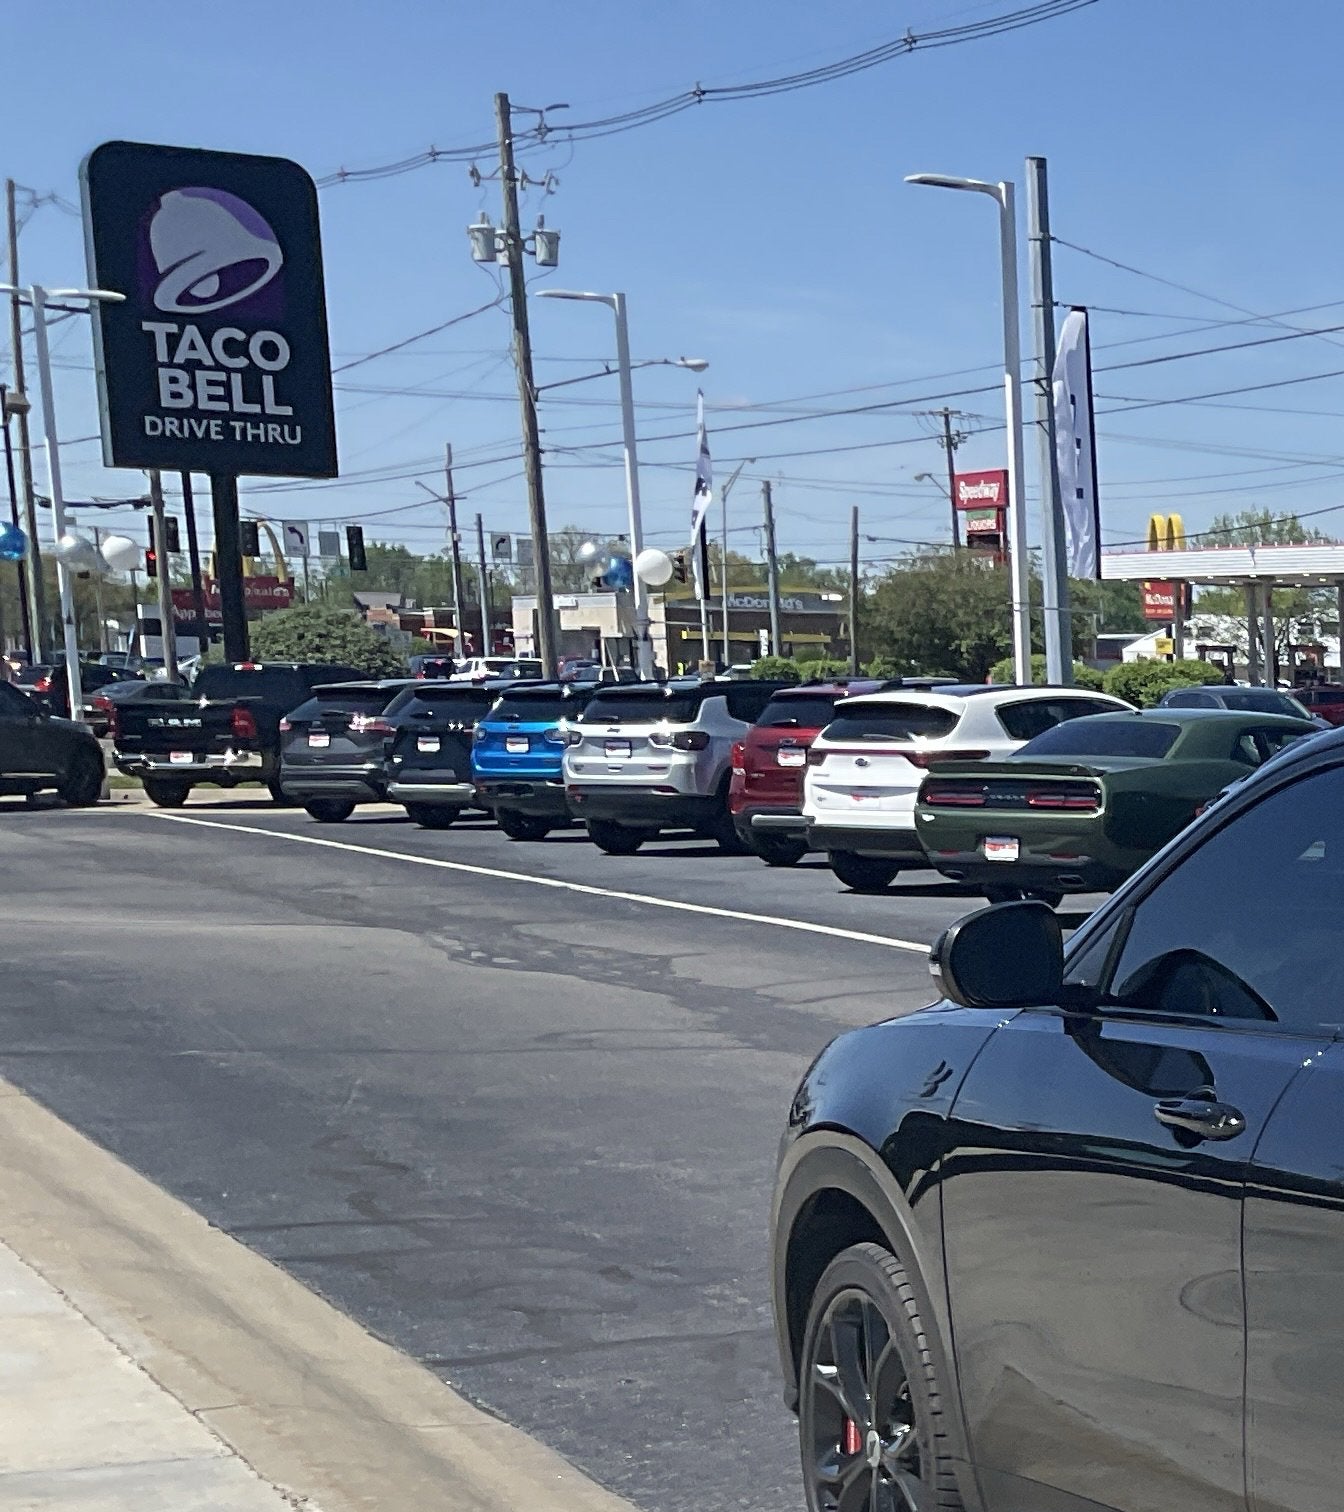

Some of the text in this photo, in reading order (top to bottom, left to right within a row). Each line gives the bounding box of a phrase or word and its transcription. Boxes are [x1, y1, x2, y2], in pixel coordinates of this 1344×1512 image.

[142, 321, 290, 371] TACO
[158, 367, 293, 416] BELL
[144, 415, 302, 445] DRIVE THRU
[959, 480, 1000, 505] Speedway
